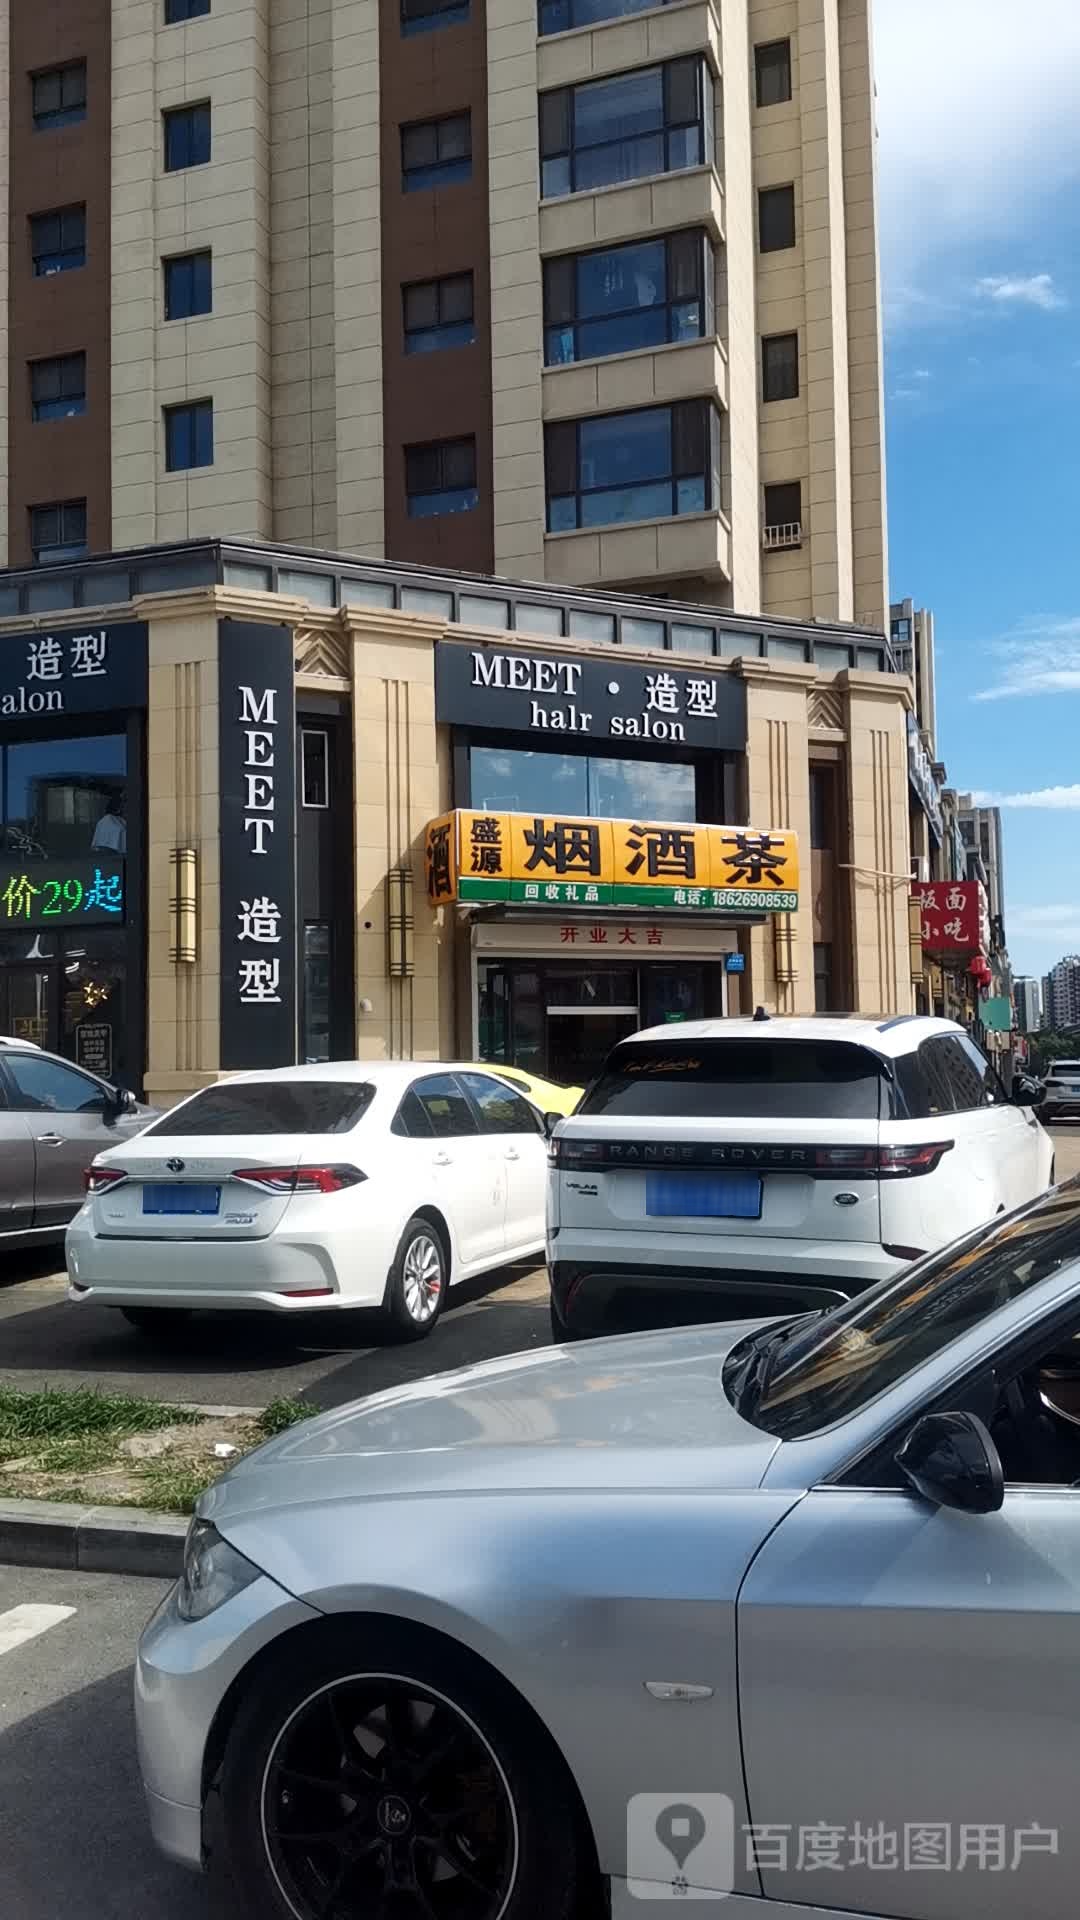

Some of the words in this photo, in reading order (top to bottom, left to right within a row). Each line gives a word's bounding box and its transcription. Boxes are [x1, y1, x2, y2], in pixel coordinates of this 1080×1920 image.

[26, 631, 107, 680] 造型
[0, 686, 64, 714] alon
[470, 652, 582, 695] MEET
[645, 673, 719, 718] 造型
[610, 713, 686, 741] salon
[238, 686, 279, 854] MEET
[428, 823, 453, 898] 酒
[470, 817, 503, 874] 盛源
[523, 818, 788, 887] 烟酒茶
[2, 868, 123, 918] 价29起
[525, 884, 599, 901] 回收礼品
[920, 886, 967, 913] 板面
[237, 896, 282, 1003] 造型
[560, 927, 664, 945] 开业大吉
[922, 917, 970, 942] 小吃
[609, 1145, 694, 1158] RANGE
[711, 1148, 808, 1160] ROVER
